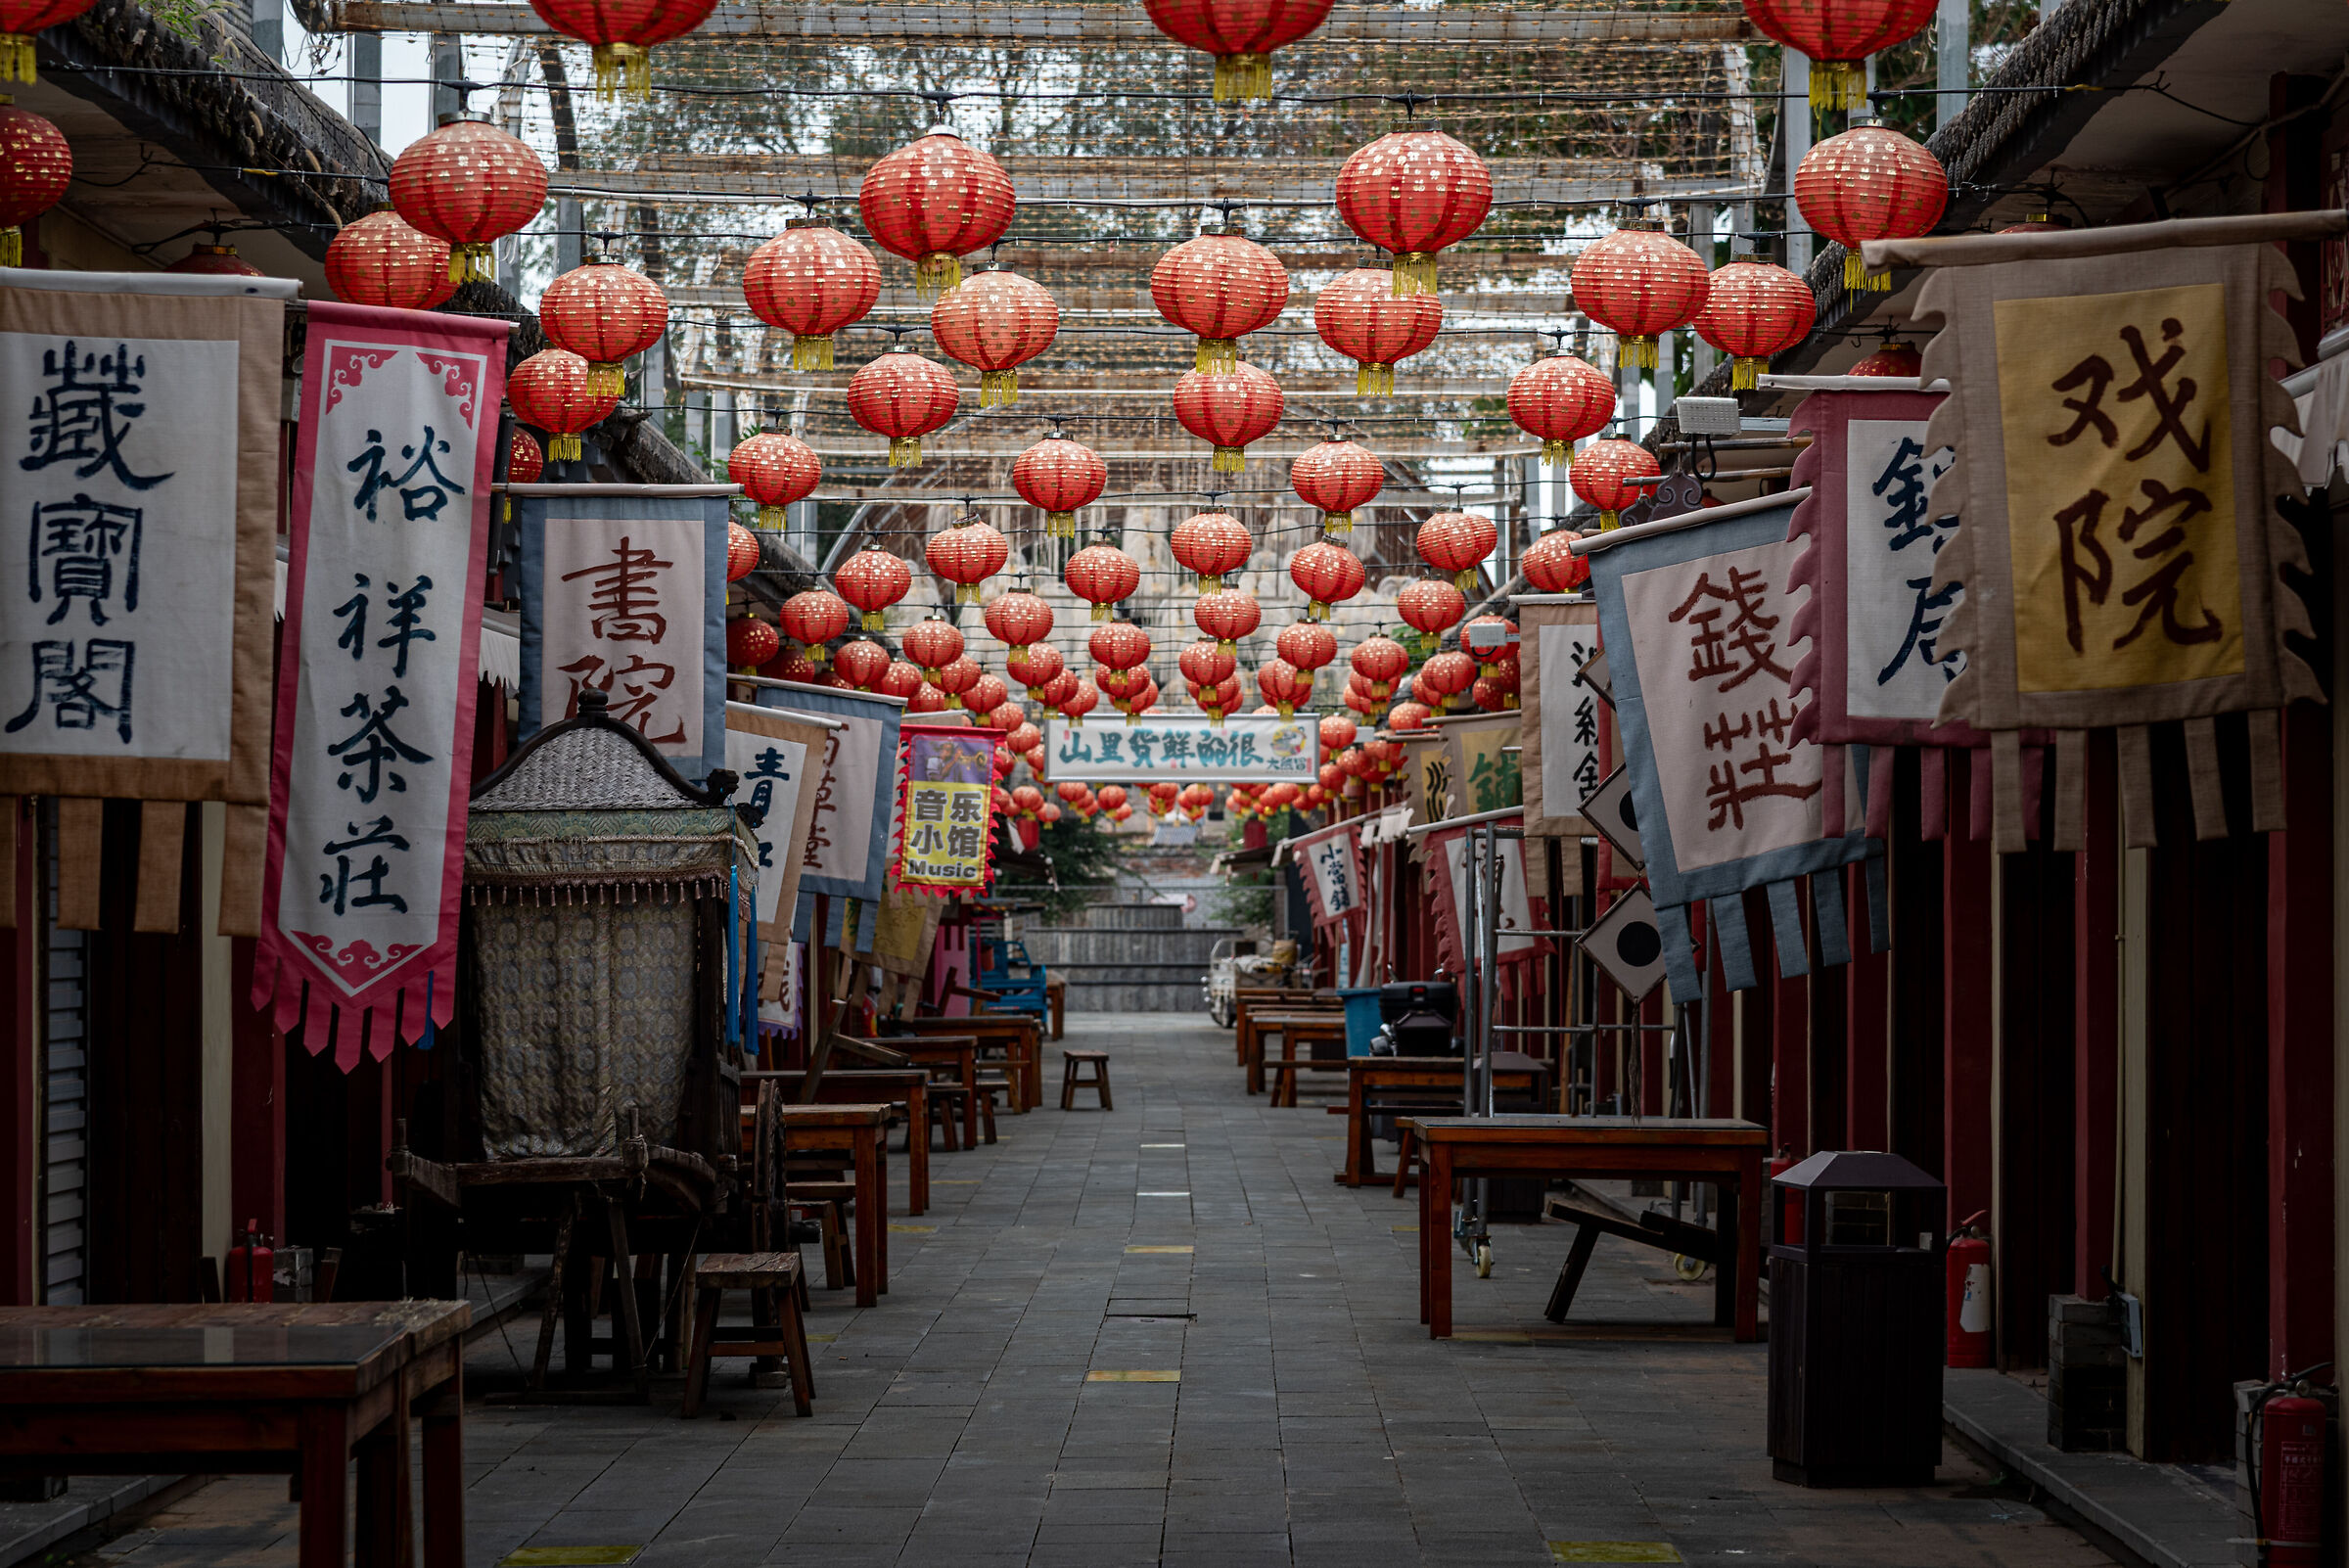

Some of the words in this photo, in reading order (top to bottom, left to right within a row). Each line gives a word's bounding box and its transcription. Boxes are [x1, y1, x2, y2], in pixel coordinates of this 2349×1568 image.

[2045, 317, 2223, 658] 戏院
[555, 536, 687, 744] 書院
[914, 790, 982, 822] 音乐
[909, 824, 981, 857] 小馆
[908, 859, 977, 878] Music
